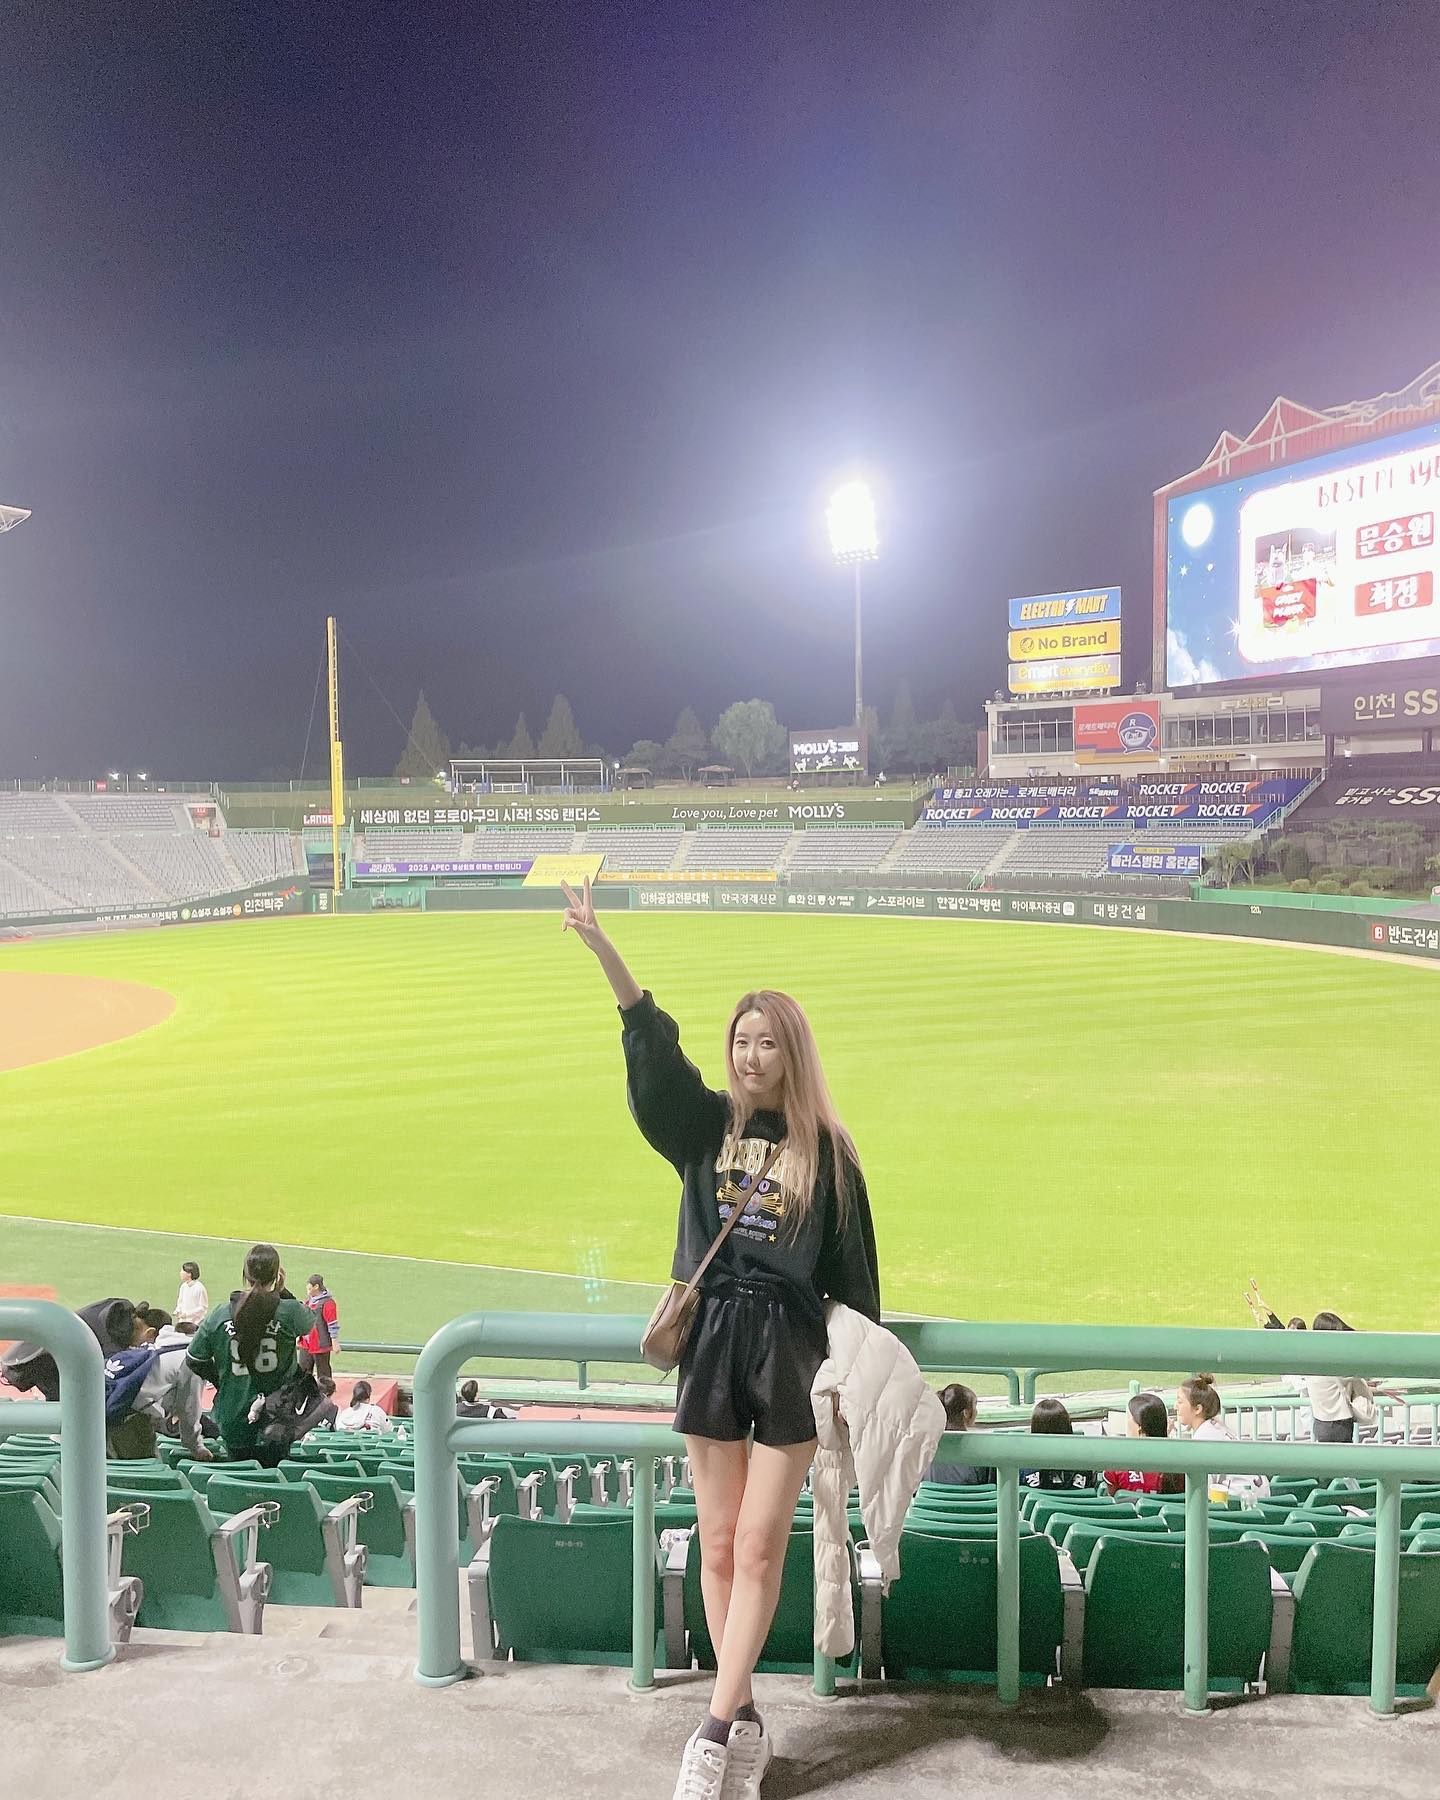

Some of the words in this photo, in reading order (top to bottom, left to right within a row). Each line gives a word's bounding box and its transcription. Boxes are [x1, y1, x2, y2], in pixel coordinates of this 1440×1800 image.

[1358, 513, 1431, 556] 문승원
[1369, 576, 1418, 610] 최정
[1020, 600, 1065, 620] ELECTRO
[1075, 594, 1109, 614] MART
[1038, 638, 1058, 650] No
[1062, 631, 1107, 648] Brand
[1354, 692, 1396, 720] 인천
[954, 788, 972, 799] 좋고
[1017, 786, 1077, 798] 로케트배터리
[1140, 784, 1188, 796] ROCKET
[1200, 781, 1250, 794] ROCKET
[360, 809, 400, 824] 세상에
[404, 809, 430, 824] 없던
[433, 808, 499, 823] 프로야구의
[503, 807, 533, 822] 시작!
[535, 807, 560, 821] SSG
[562, 807, 601, 821] 랜더스
[672, 807, 700, 819] Love
[700, 808, 727, 820] you,
[729, 806, 757, 819] Love
[757, 807, 778, 820] pet
[788, 802, 845, 819] MOLLY'S
[926, 807, 974, 820] ROCKET
[991, 807, 1038, 819] ROCKET
[1058, 806, 1109, 818] ROCKET
[1127, 805, 1178, 818] ROCKET
[1197, 804, 1250, 817] ROCKET
[408, 864, 428, 872] 2025
[430, 864, 450, 872] APEC
[1111, 854, 1163, 869] 플러스병원
[244, 898, 284, 913] 인천탁주
[721, 892, 777, 905] 한국경제신문
[877, 895, 925, 909] 스포라이브
[936, 896, 1001, 912] 한길안과병원
[1011, 900, 1061, 915] 하이투자증권
[1388, 924, 1440, 950] 반도건설
